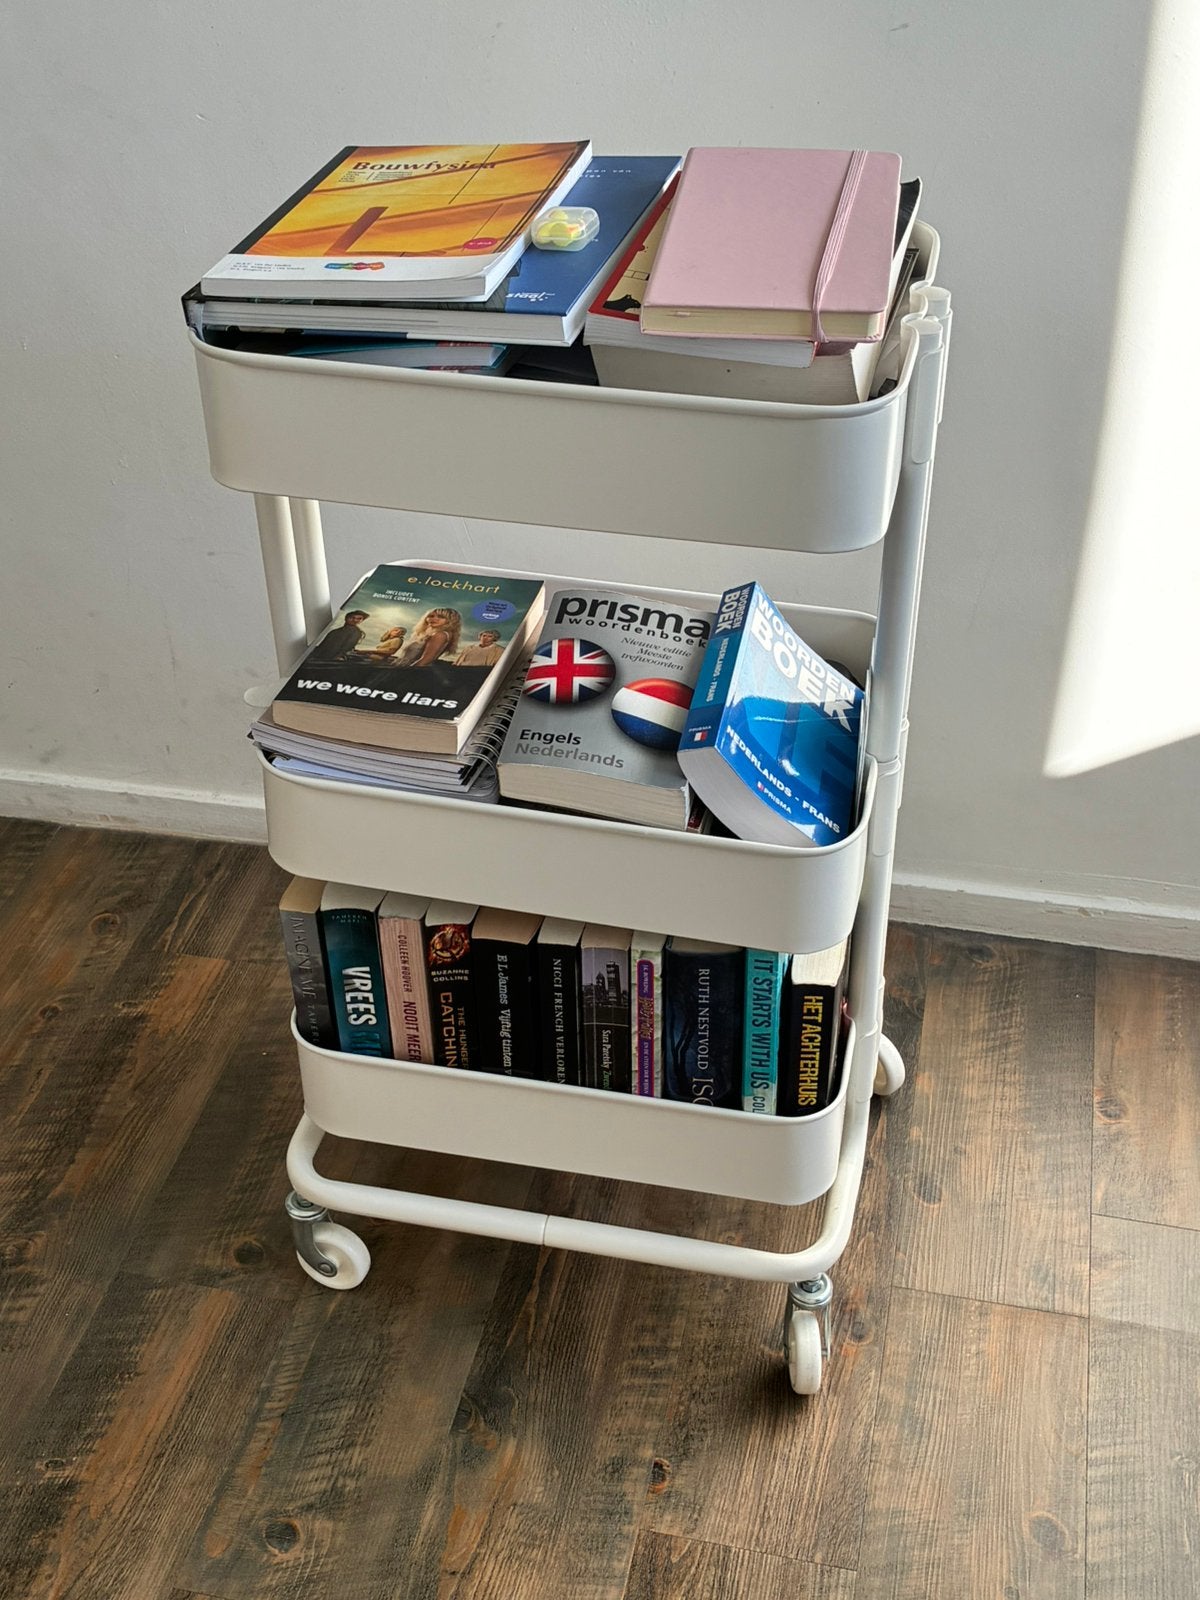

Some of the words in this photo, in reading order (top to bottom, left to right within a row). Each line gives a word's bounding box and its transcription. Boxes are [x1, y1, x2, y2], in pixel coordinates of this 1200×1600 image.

[373, 592, 393, 601] BONUS
[394, 595, 421, 603] CONTENT
[385, 589, 414, 598] INCLUDES
[407, 576, 500, 594] e.lockhart
[554, 596, 711, 641] prisma
[715, 590, 741, 634] BOEK
[732, 585, 751, 629] WOORDEN
[568, 616, 708, 649] woordenboek
[620, 636, 661, 650] Nieuwe
[662, 642, 692, 658] editie
[620, 652, 684, 671] trefwoorden
[636, 647, 672, 661] Meeste
[713, 637, 730, 677] NEDERLANDS
[755, 594, 856, 706] WOORDEN
[749, 606, 855, 734] BOEK
[297, 677, 331, 690] we
[336, 682, 398, 701] were
[401, 691, 458, 710] liars
[706, 681, 718, 703] FRANS
[519, 728, 581, 746] Engels
[514, 742, 624, 768] Nederlands
[726, 724, 793, 798] NEDERLANDS
[802, 799, 841, 834] FRANS
[763, 787, 792, 815] PRISMA
[290, 916, 311, 973] IMAGINE
[397, 934, 409, 965] COLLEEN
[496, 953, 508, 962] E
[400, 965, 412, 993] HOOVER
[552, 958, 563, 988] NICCI
[754, 958, 774, 973] IT
[299, 976, 317, 1000] ME
[342, 966, 377, 1026] VREES
[497, 972, 509, 1005] James
[698, 968, 710, 1003] RUTH
[402, 1000, 419, 1033] NOOIT
[456, 1007, 466, 1026] THE
[554, 991, 564, 1032] FRENCH
[752, 977, 773, 1028] STARTS
[803, 995, 824, 1022] HET
[440, 991, 458, 1067] CATCHIN
[499, 1009, 511, 1038] Vijftig
[601, 1029, 612, 1044] Sara
[697, 1007, 710, 1070] NESTVOLD
[405, 1033, 422, 1062] MEER
[502, 1038, 512, 1067] tinten
[556, 1035, 566, 1085] VERLOREN
[600, 1044, 612, 1069] Paretsky
[751, 1032, 771, 1068] WITH
[797, 1023, 822, 1106] ACHTERHUIS
[751, 1071, 770, 1090] US
